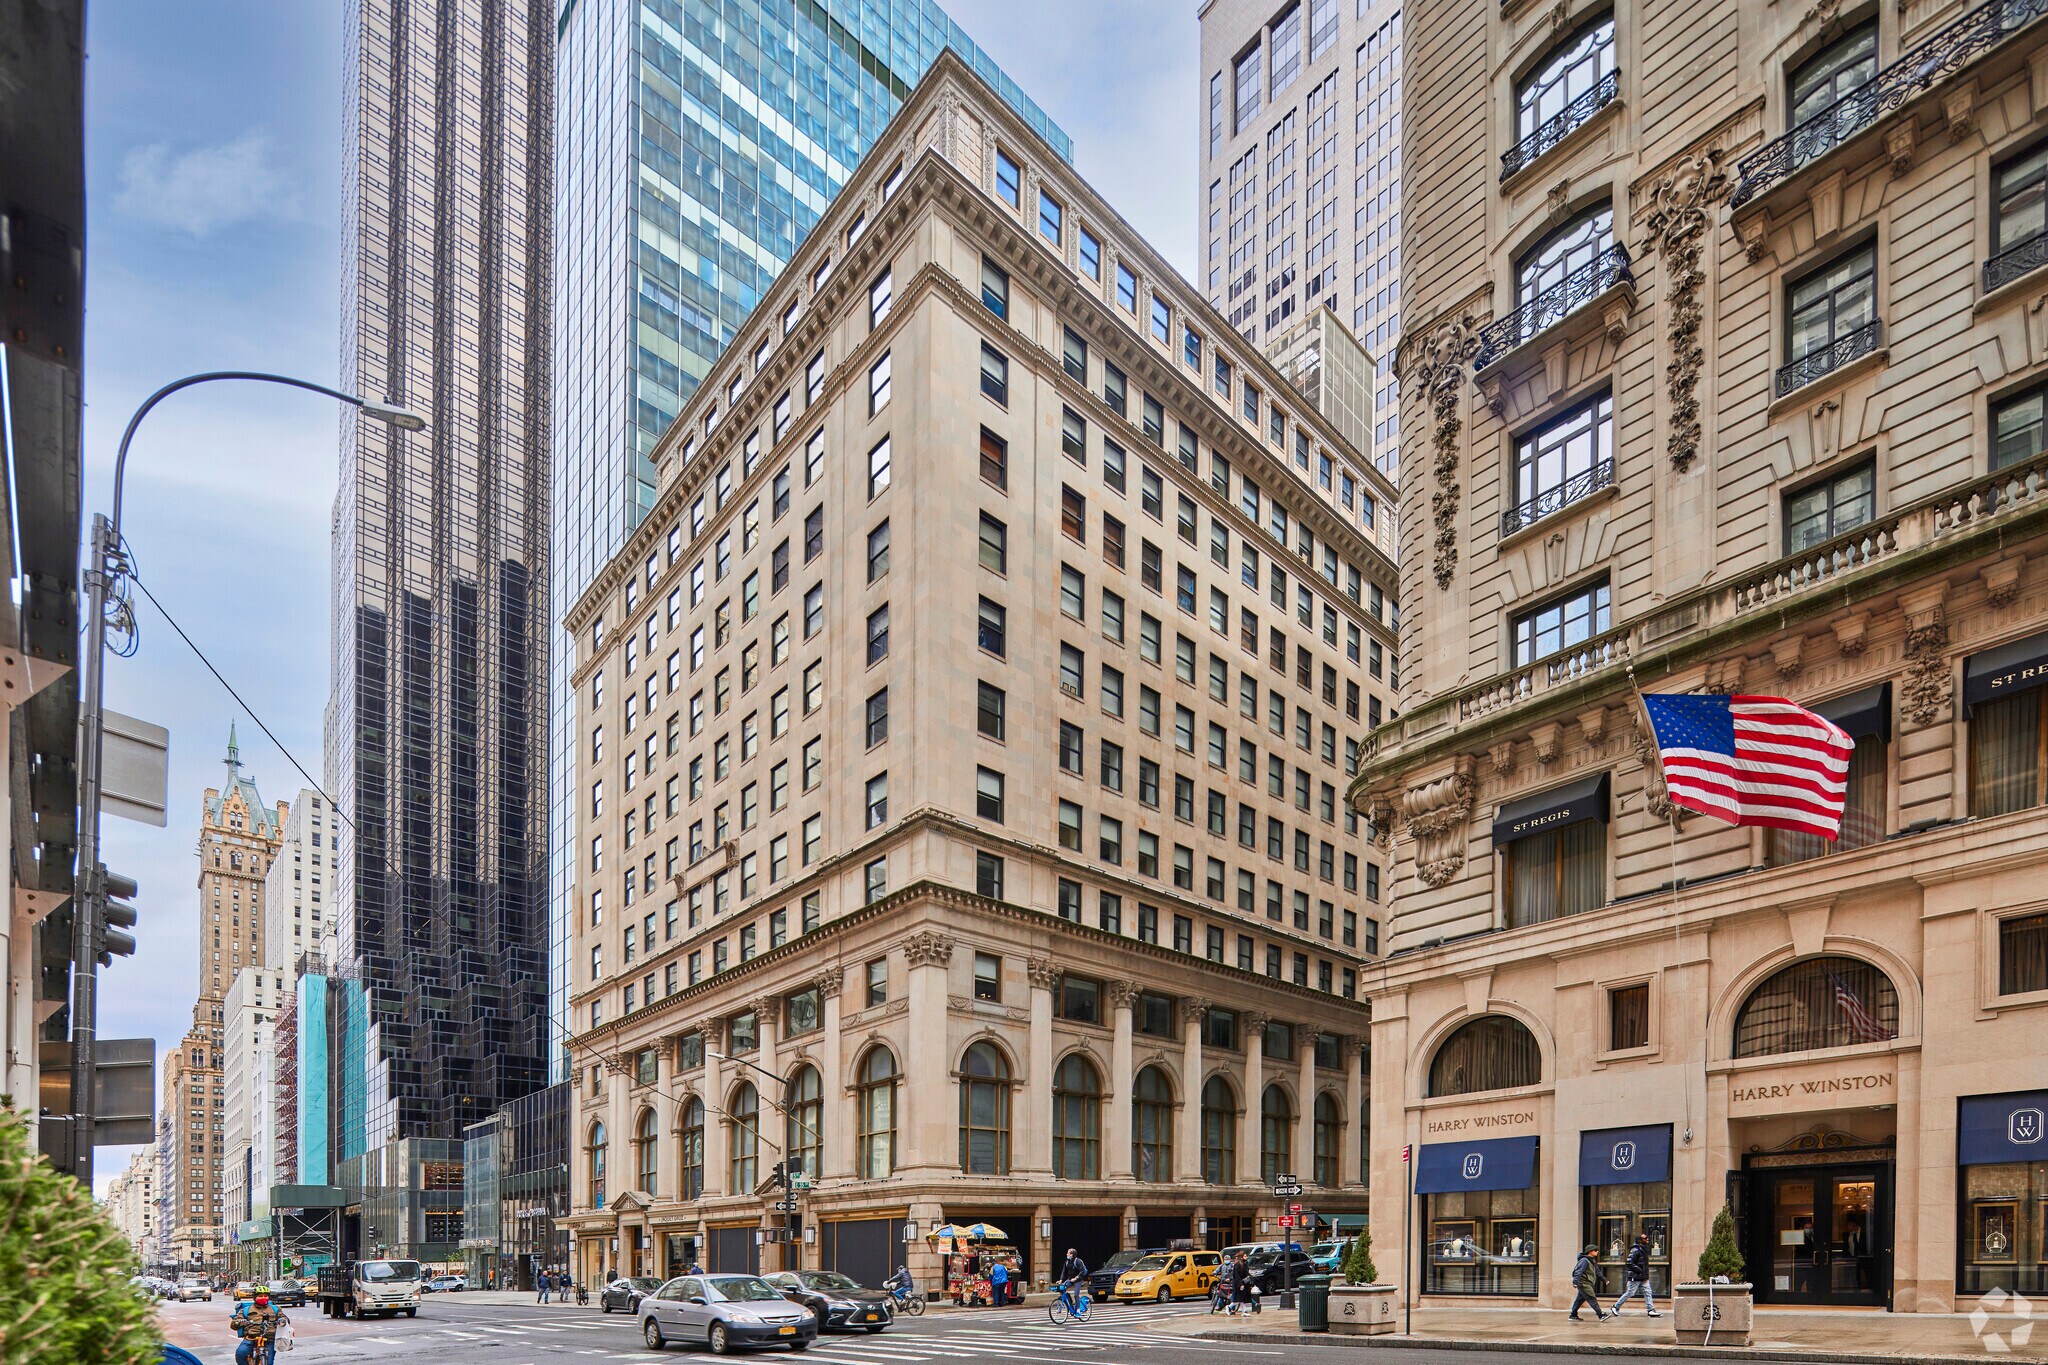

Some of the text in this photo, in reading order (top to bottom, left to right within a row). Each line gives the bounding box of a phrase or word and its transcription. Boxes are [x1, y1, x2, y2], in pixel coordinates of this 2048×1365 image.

[1530, 809, 1570, 828] REGIS
[1733, 1073, 1893, 1102] HARRY WINSTON
[1428, 1111, 1534, 1133] HARRY WINSTON
